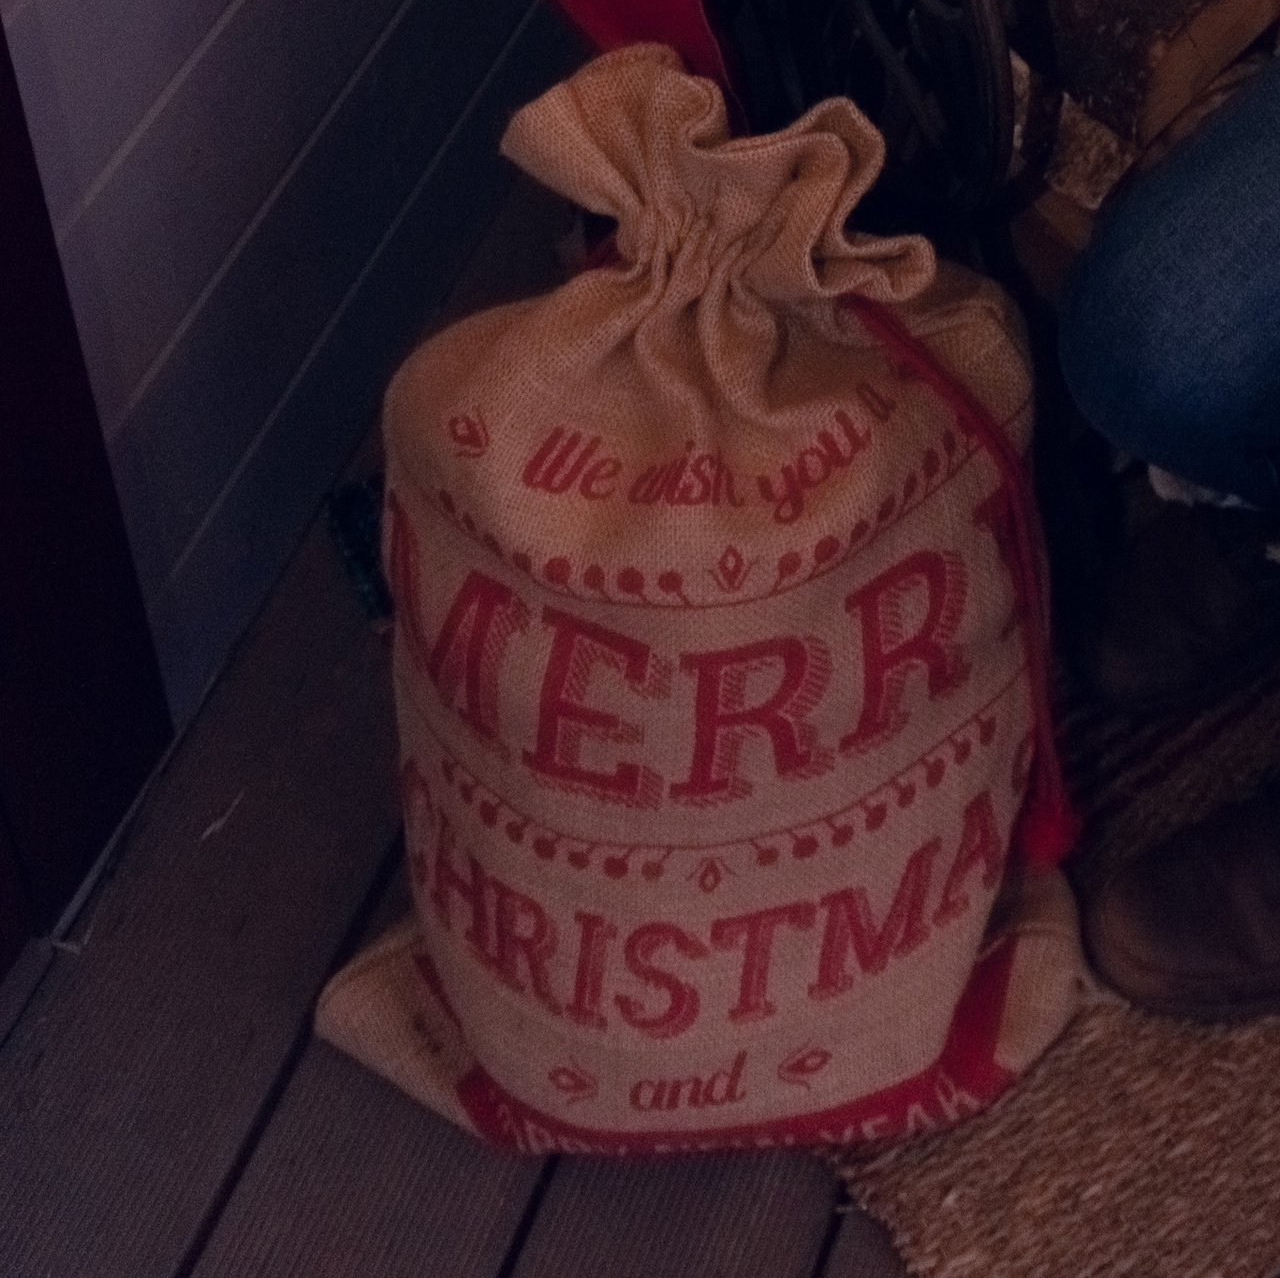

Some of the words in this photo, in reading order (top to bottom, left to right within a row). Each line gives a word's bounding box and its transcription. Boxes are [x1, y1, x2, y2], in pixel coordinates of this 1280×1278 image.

[521, 424, 622, 501] We
[757, 409, 873, 524] you
[388, 488, 1020, 809] MERR
[404, 755, 1026, 1039] CHRISTMA
[628, 1049, 749, 1112] and
